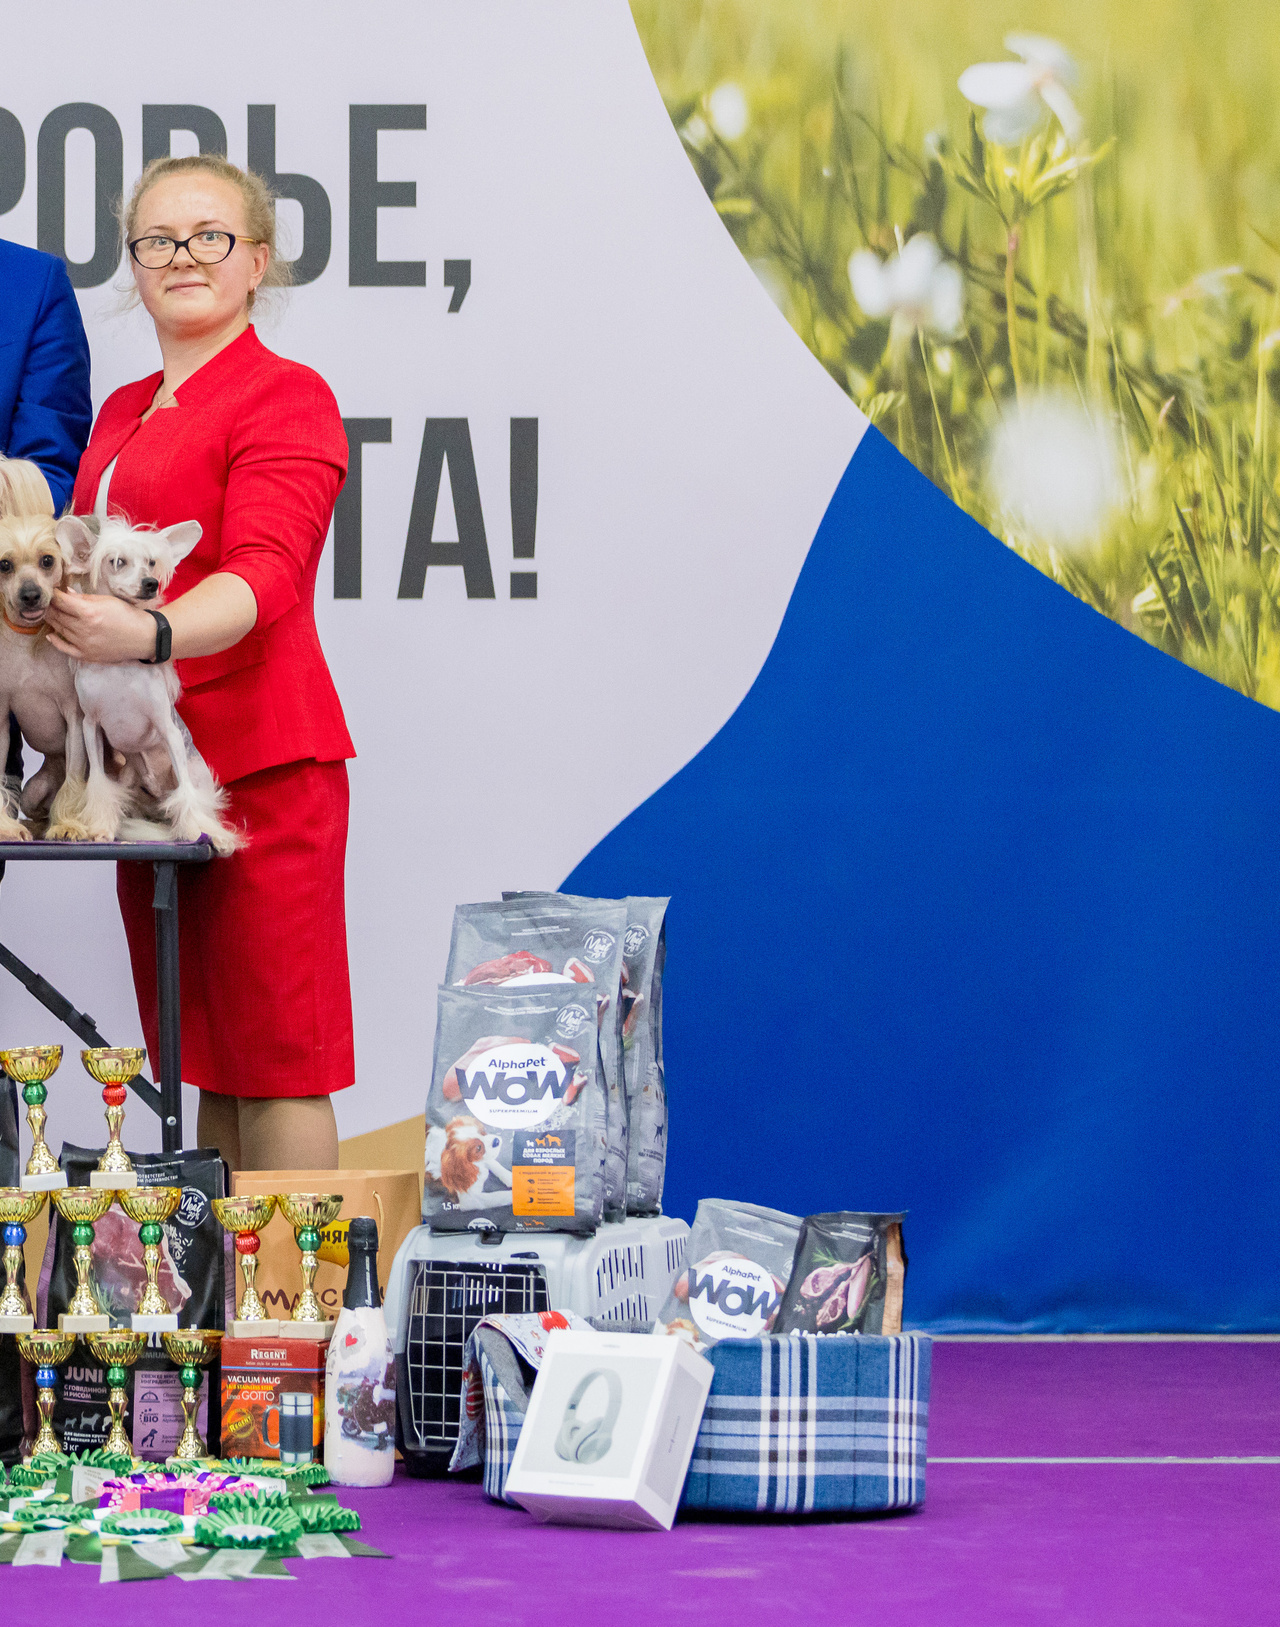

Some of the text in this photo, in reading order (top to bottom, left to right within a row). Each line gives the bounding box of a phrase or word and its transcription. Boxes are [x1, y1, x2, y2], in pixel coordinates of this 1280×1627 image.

[332, 417, 539, 600] ТА!
[488, 1056, 546, 1070] AlphaPet
[455, 1070, 577, 1106] WOW
[721, 1264, 763, 1283] AlphaPet
[687, 1267, 782, 1320] WOW
[250, 1348, 286, 1360] REGENT
[64, 1365, 103, 1384] JUNI
[227, 1375, 280, 1385] VACUUM MUG
[241, 1390, 275, 1402] GOTTO
[62, 1441, 68, 1452] 3
